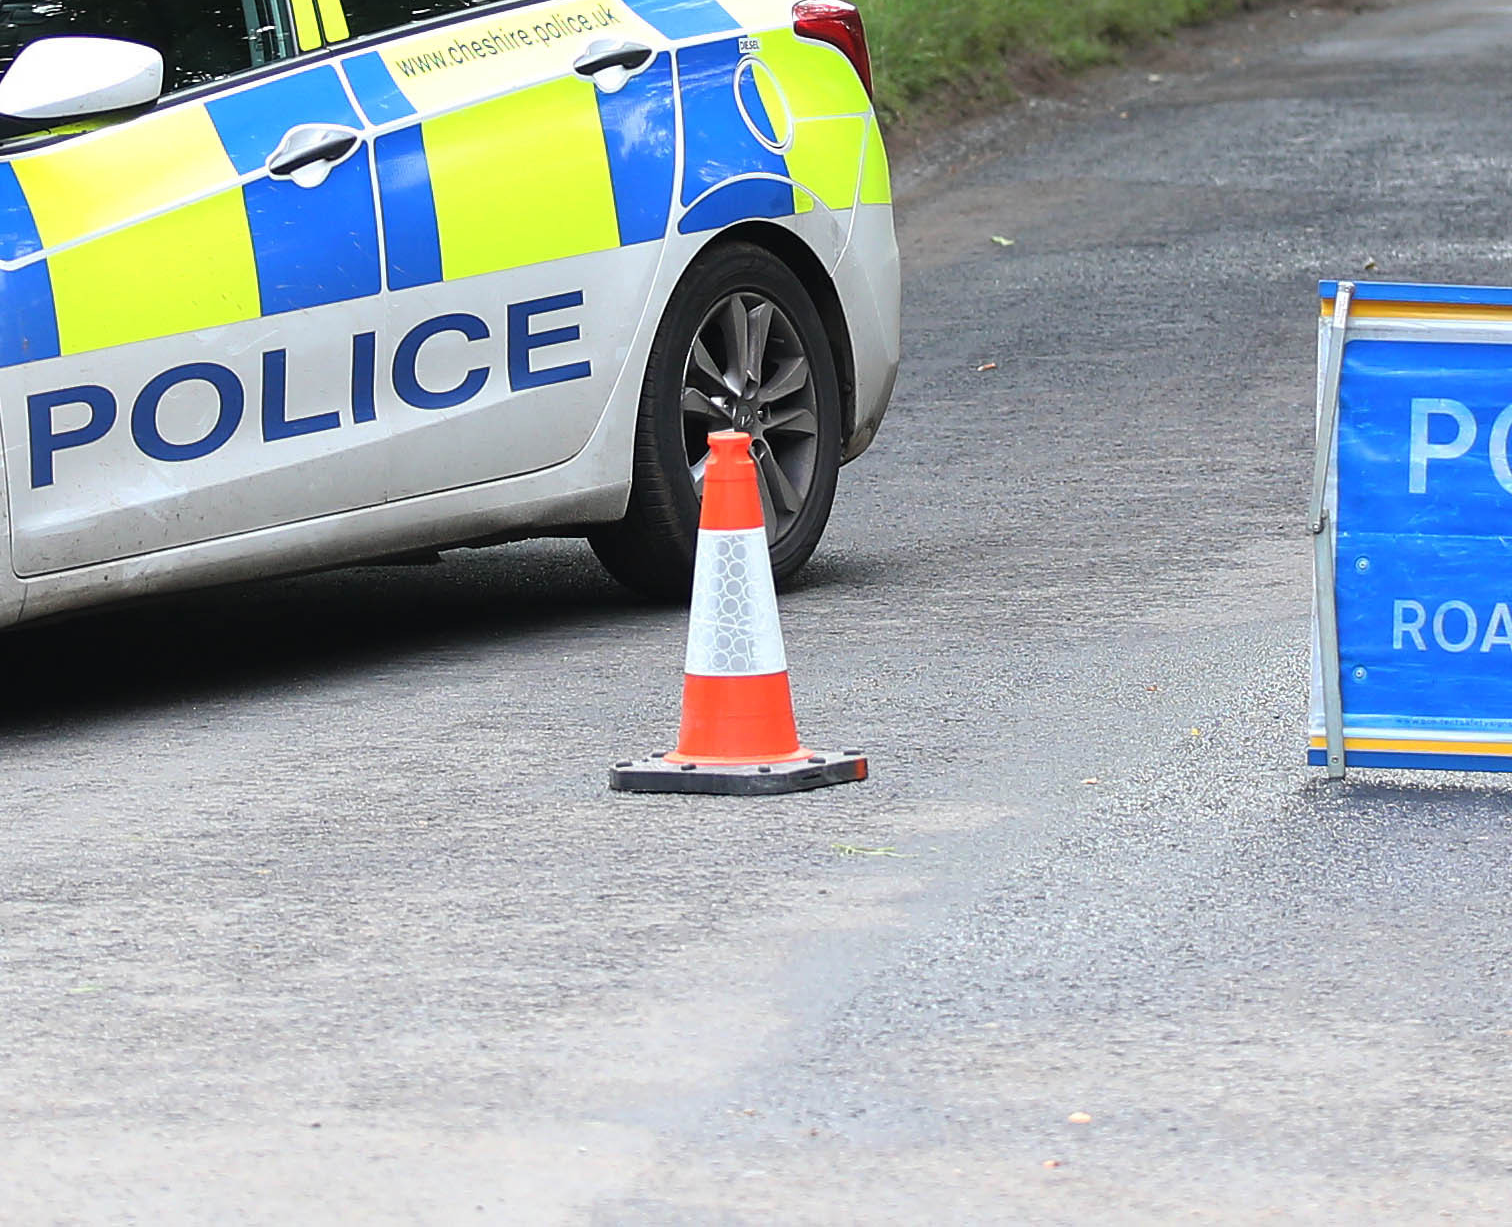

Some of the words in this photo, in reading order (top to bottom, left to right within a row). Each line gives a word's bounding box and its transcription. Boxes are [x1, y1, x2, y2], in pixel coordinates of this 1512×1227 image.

[395, 4, 620, 77] www.cheshire.police.uk
[739, 39, 760, 51] DIESEL
[26, 289, 592, 490] POLICE
